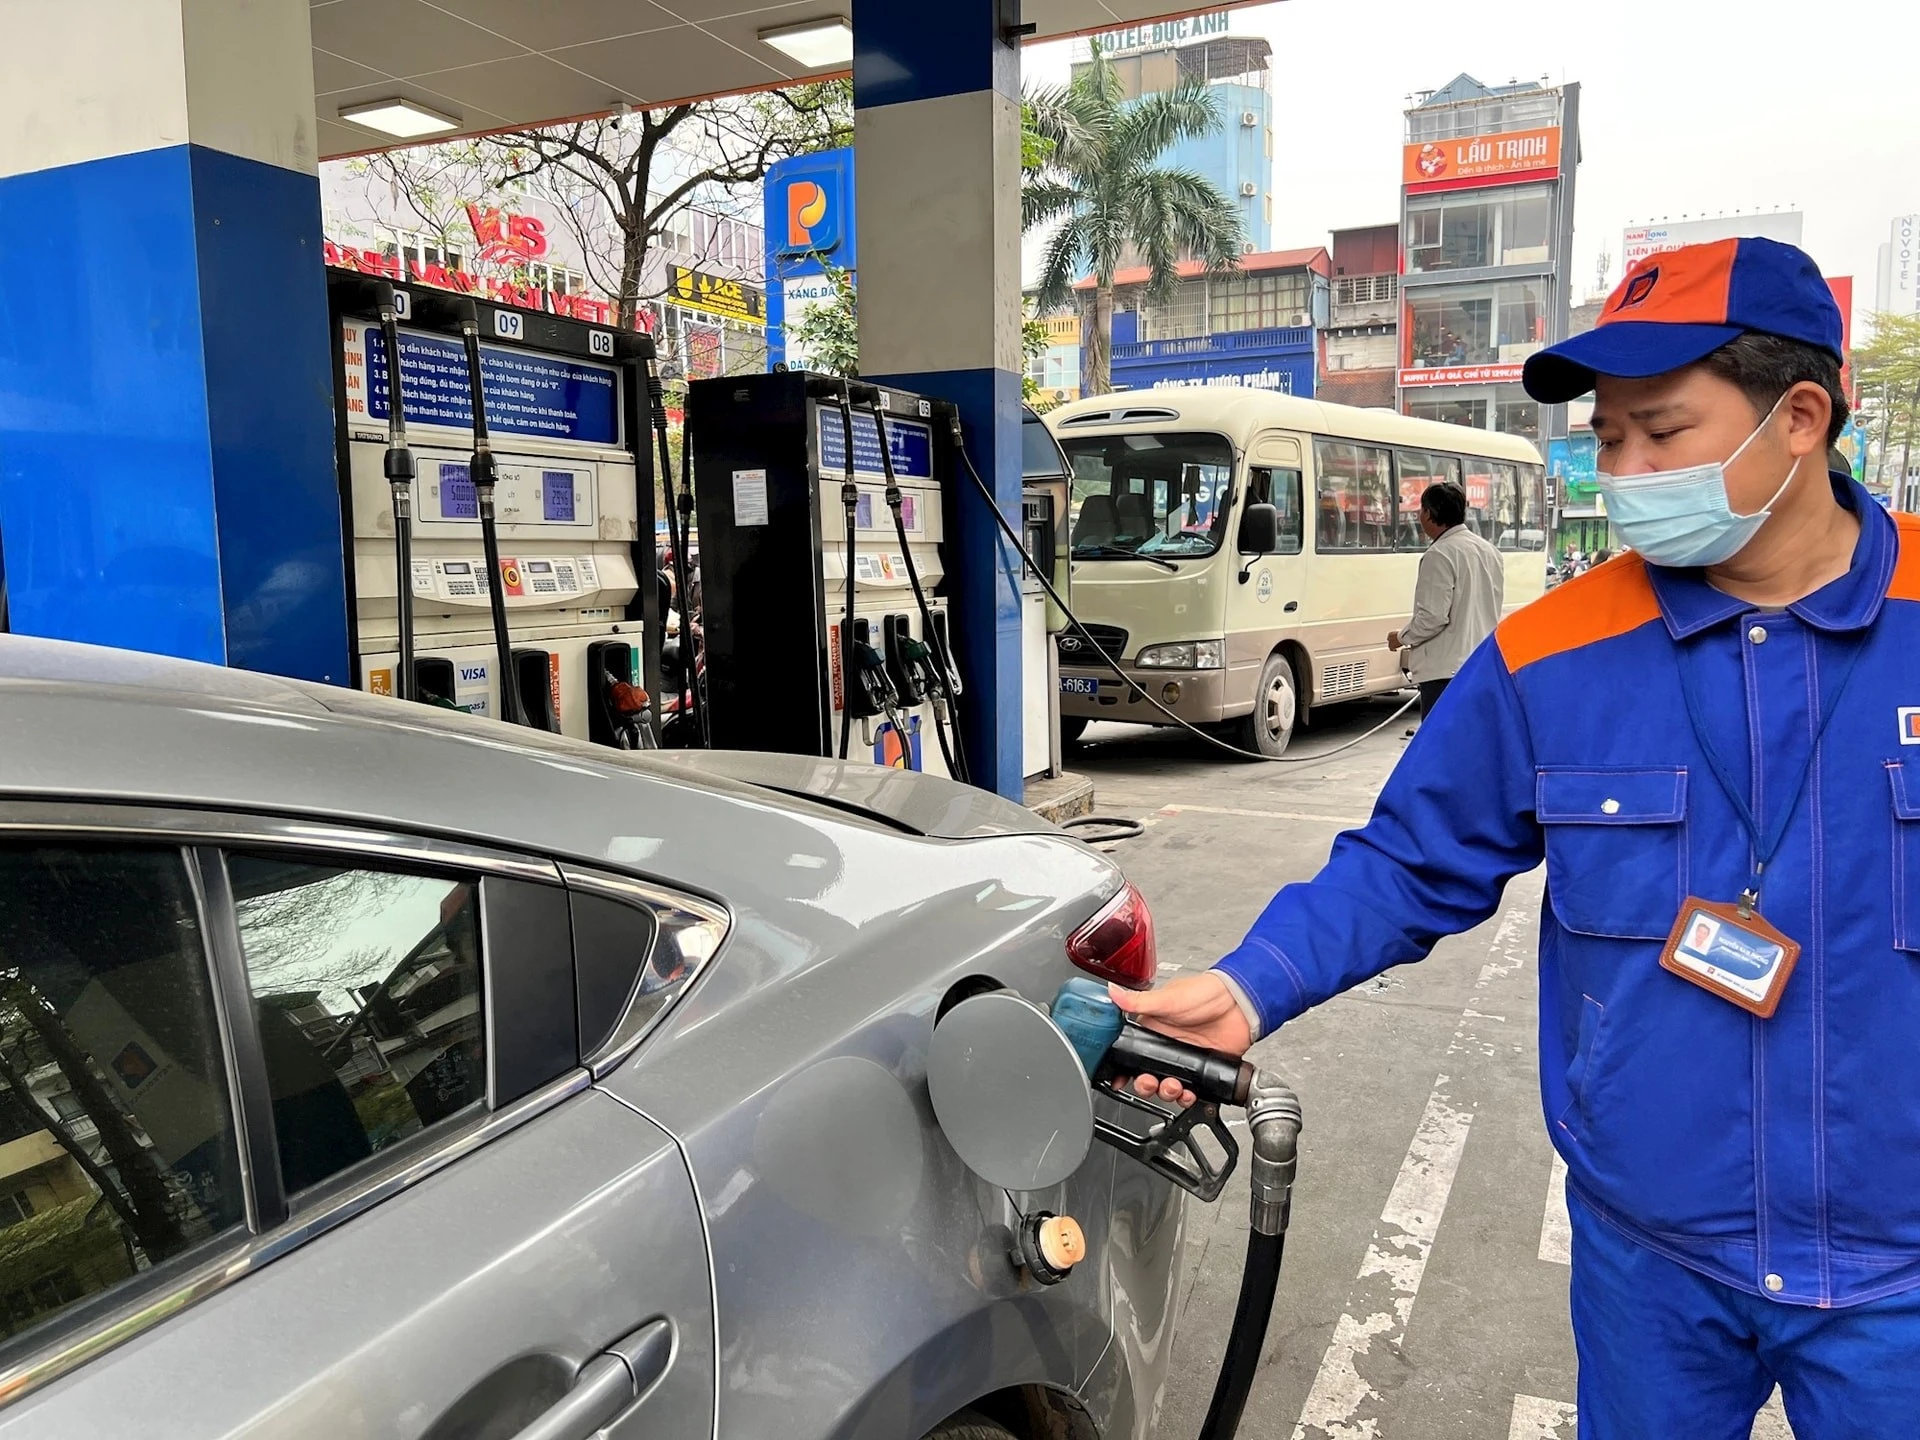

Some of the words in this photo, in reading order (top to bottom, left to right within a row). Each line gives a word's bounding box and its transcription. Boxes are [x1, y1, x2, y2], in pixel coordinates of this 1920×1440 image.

[1457, 138, 1491, 165] LẨU
[1495, 136, 1548, 161] TRỊNH
[1900, 218, 1912, 290] NOVOTEL
[500, 314, 518, 335] 09
[593, 334, 610, 353] 08
[460, 667, 486, 680] VISA
